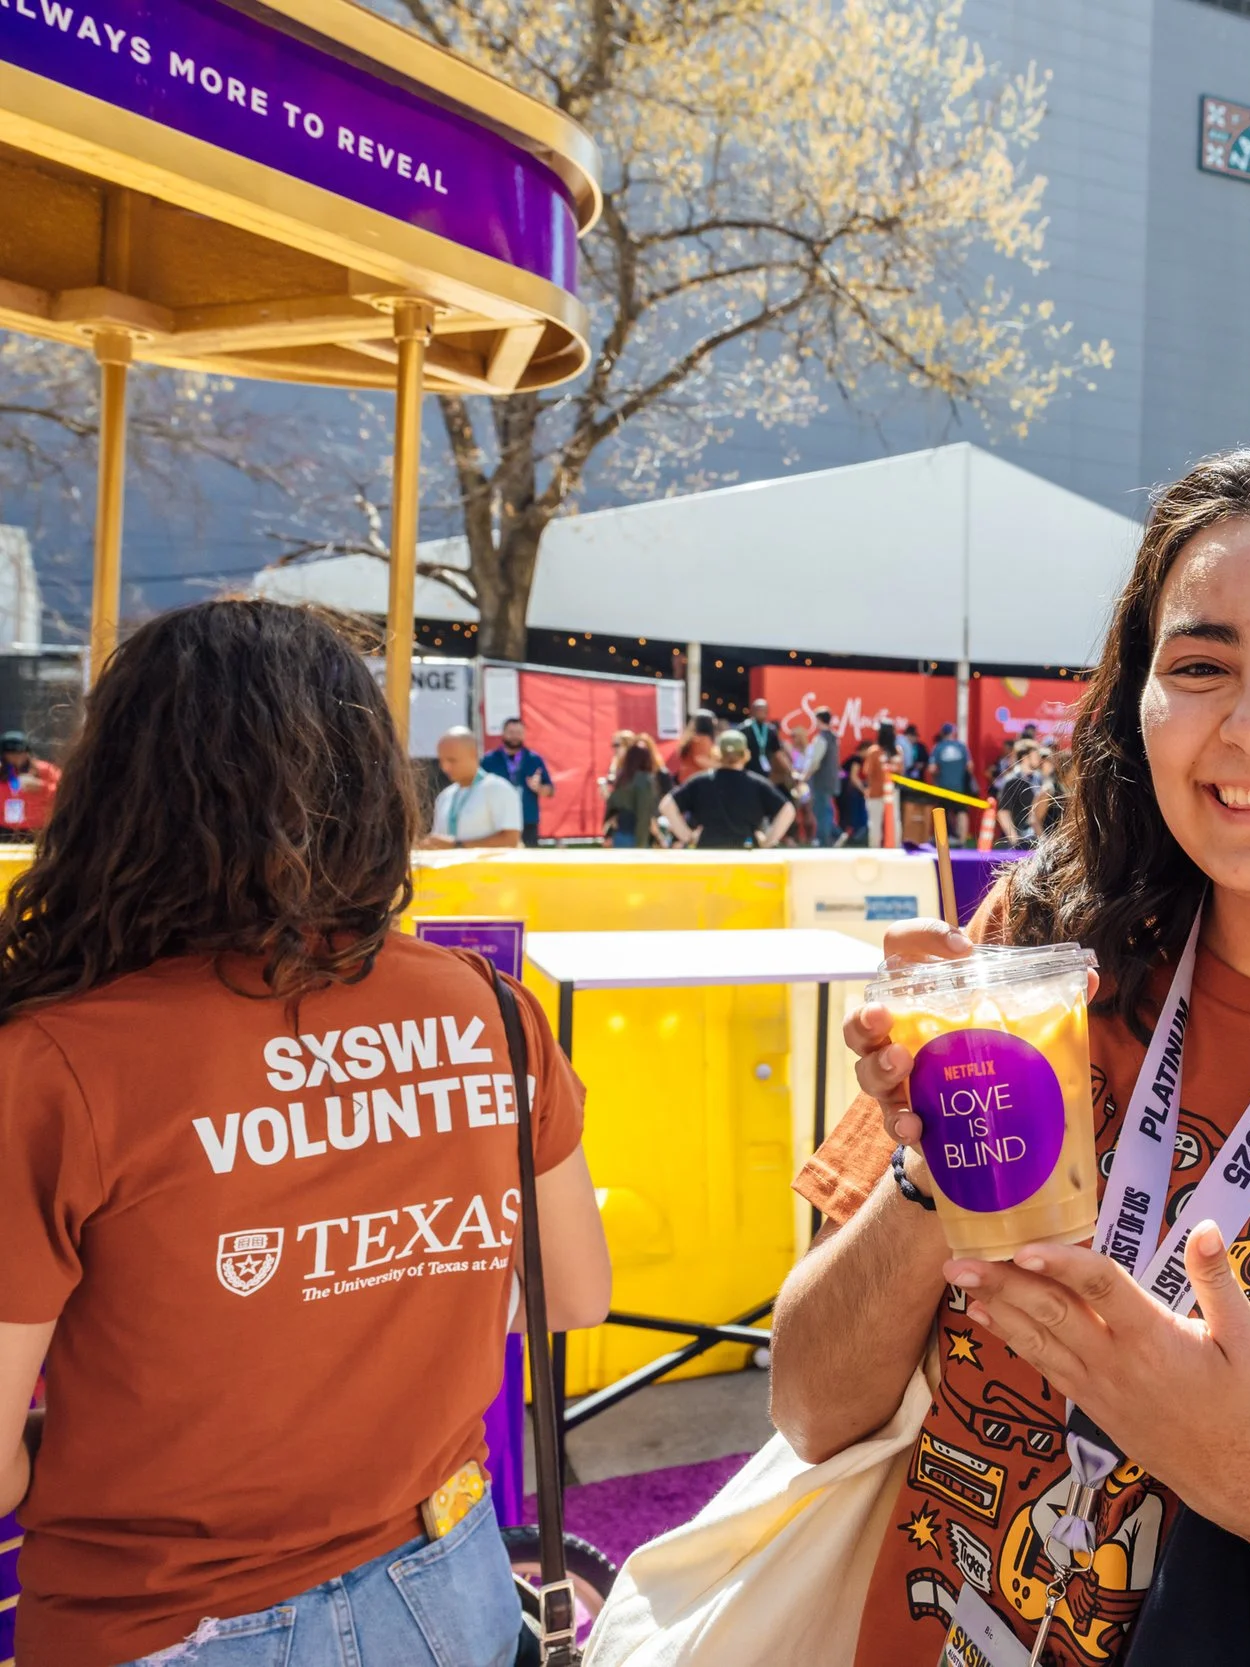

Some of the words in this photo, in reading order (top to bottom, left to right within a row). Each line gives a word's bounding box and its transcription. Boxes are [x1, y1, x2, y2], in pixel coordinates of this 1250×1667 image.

[0, 0, 152, 65] LWAYS
[169, 50, 268, 116] MORE
[283, 101, 325, 139] TO
[338, 126, 449, 195] REVEAL
[263, 1017, 437, 1091] SXSW
[943, 1060, 996, 1081] NETFLIX
[1139, 996, 1191, 1143] PLATINUM
[940, 1083, 1013, 1117] LOVE
[968, 1117, 989, 1138] IS
[943, 1135, 1026, 1169] BLIND
[1121, 1186, 1151, 1215] US
[296, 1188, 521, 1280] TEXAS
[1105, 1222, 1114, 1245] ORIGINAL
[1116, 1209, 1146, 1236] OF
[1109, 1231, 1141, 1277] AST
[302, 1286, 331, 1302] The
[334, 1267, 404, 1295] University
[407, 1262, 425, 1277] of
[428, 1259, 468, 1276] Texas
[472, 1259, 486, 1271] at
[1172, 1291, 1186, 1312] ORIGINA
